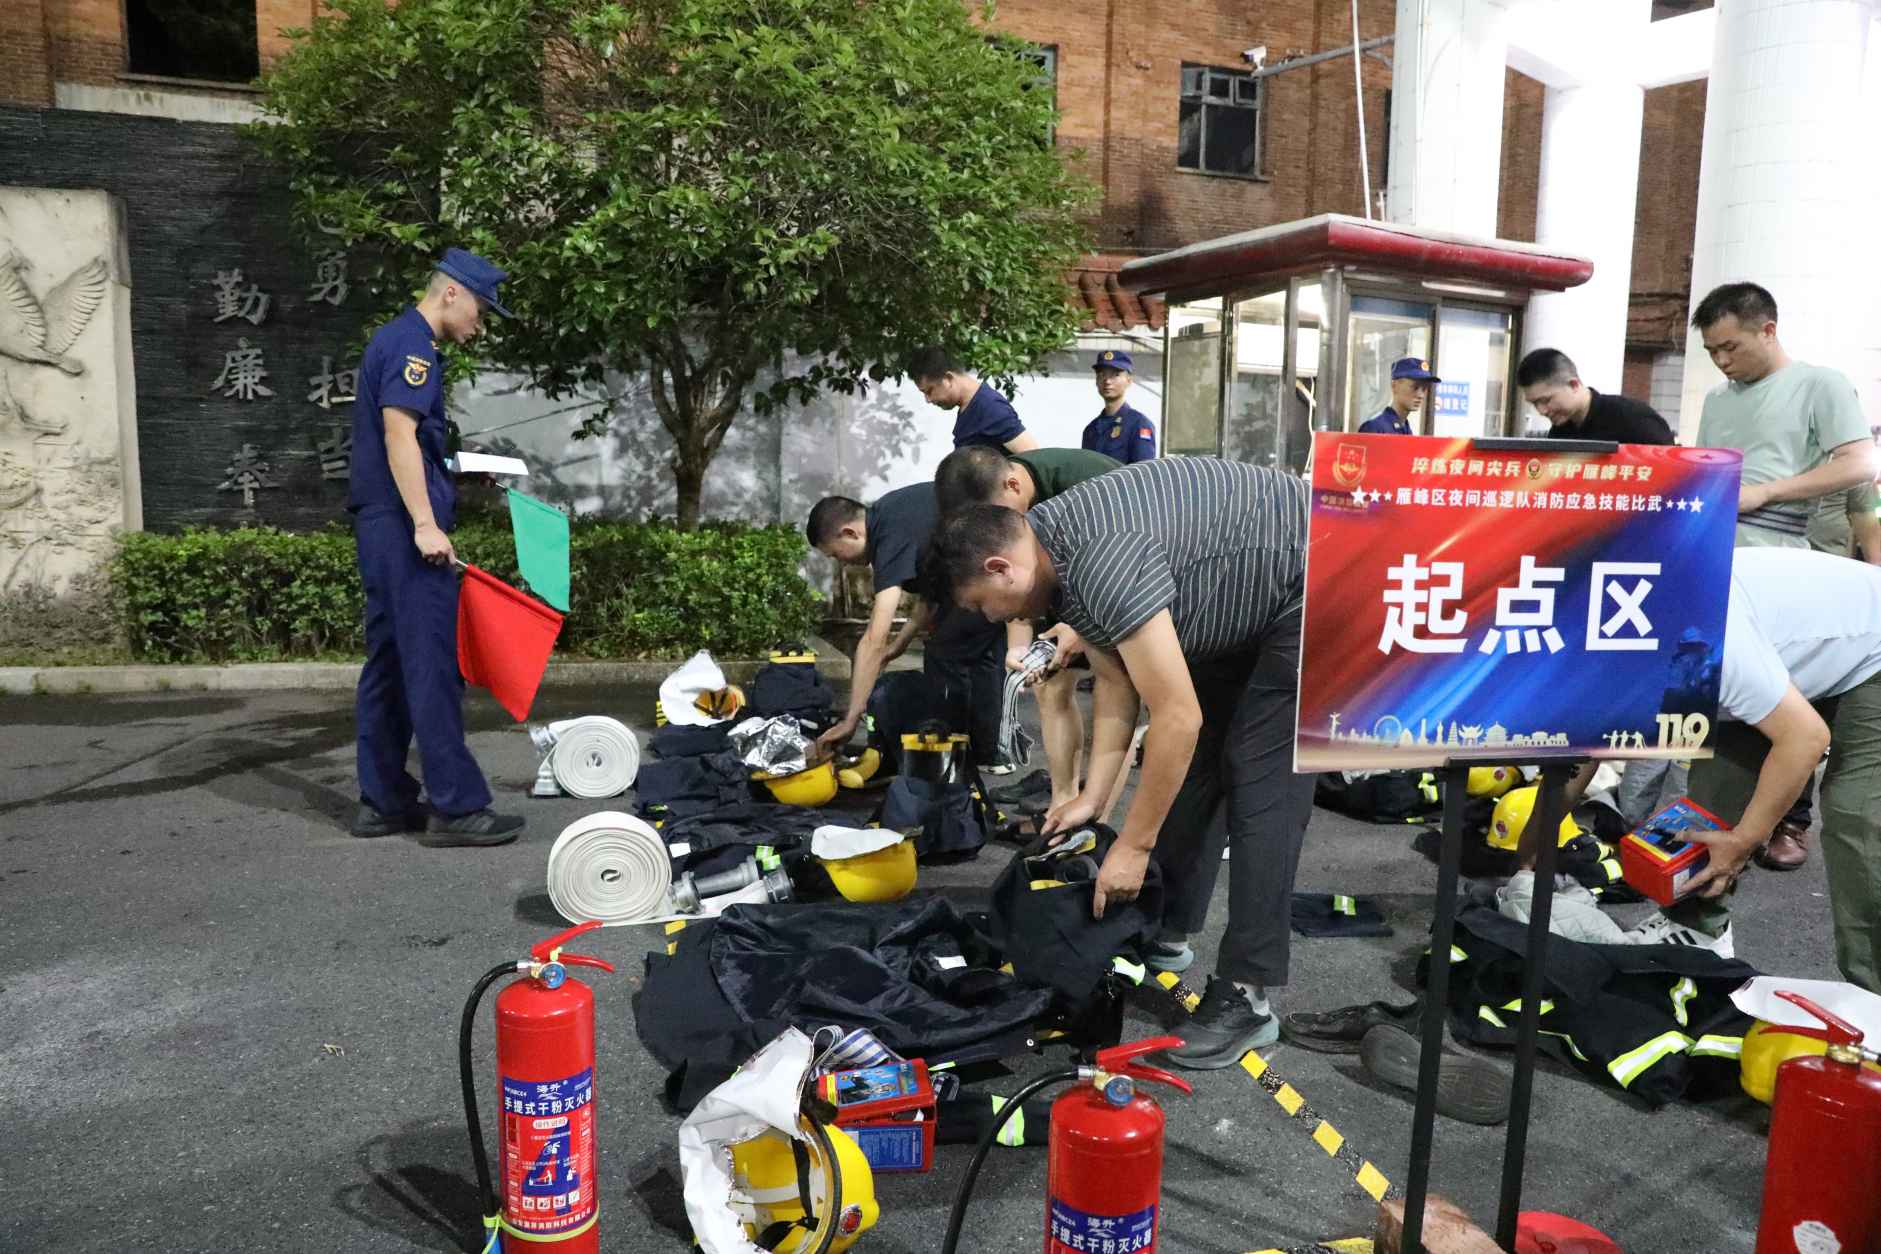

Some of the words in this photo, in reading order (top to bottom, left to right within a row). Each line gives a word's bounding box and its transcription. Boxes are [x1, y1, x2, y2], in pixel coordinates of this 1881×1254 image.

[1548, 461, 1653, 482] 守护雁峰平安
[1396, 487, 1662, 512] 雁峰区夜间巡逻队消防应急技能比武
[1378, 554, 1662, 656] 起点区
[1656, 712, 1710, 749] 119
[504, 1086, 592, 1115] 手提式干粉灭火器
[1051, 1219, 1152, 1254] 手提式干粉灭火器
